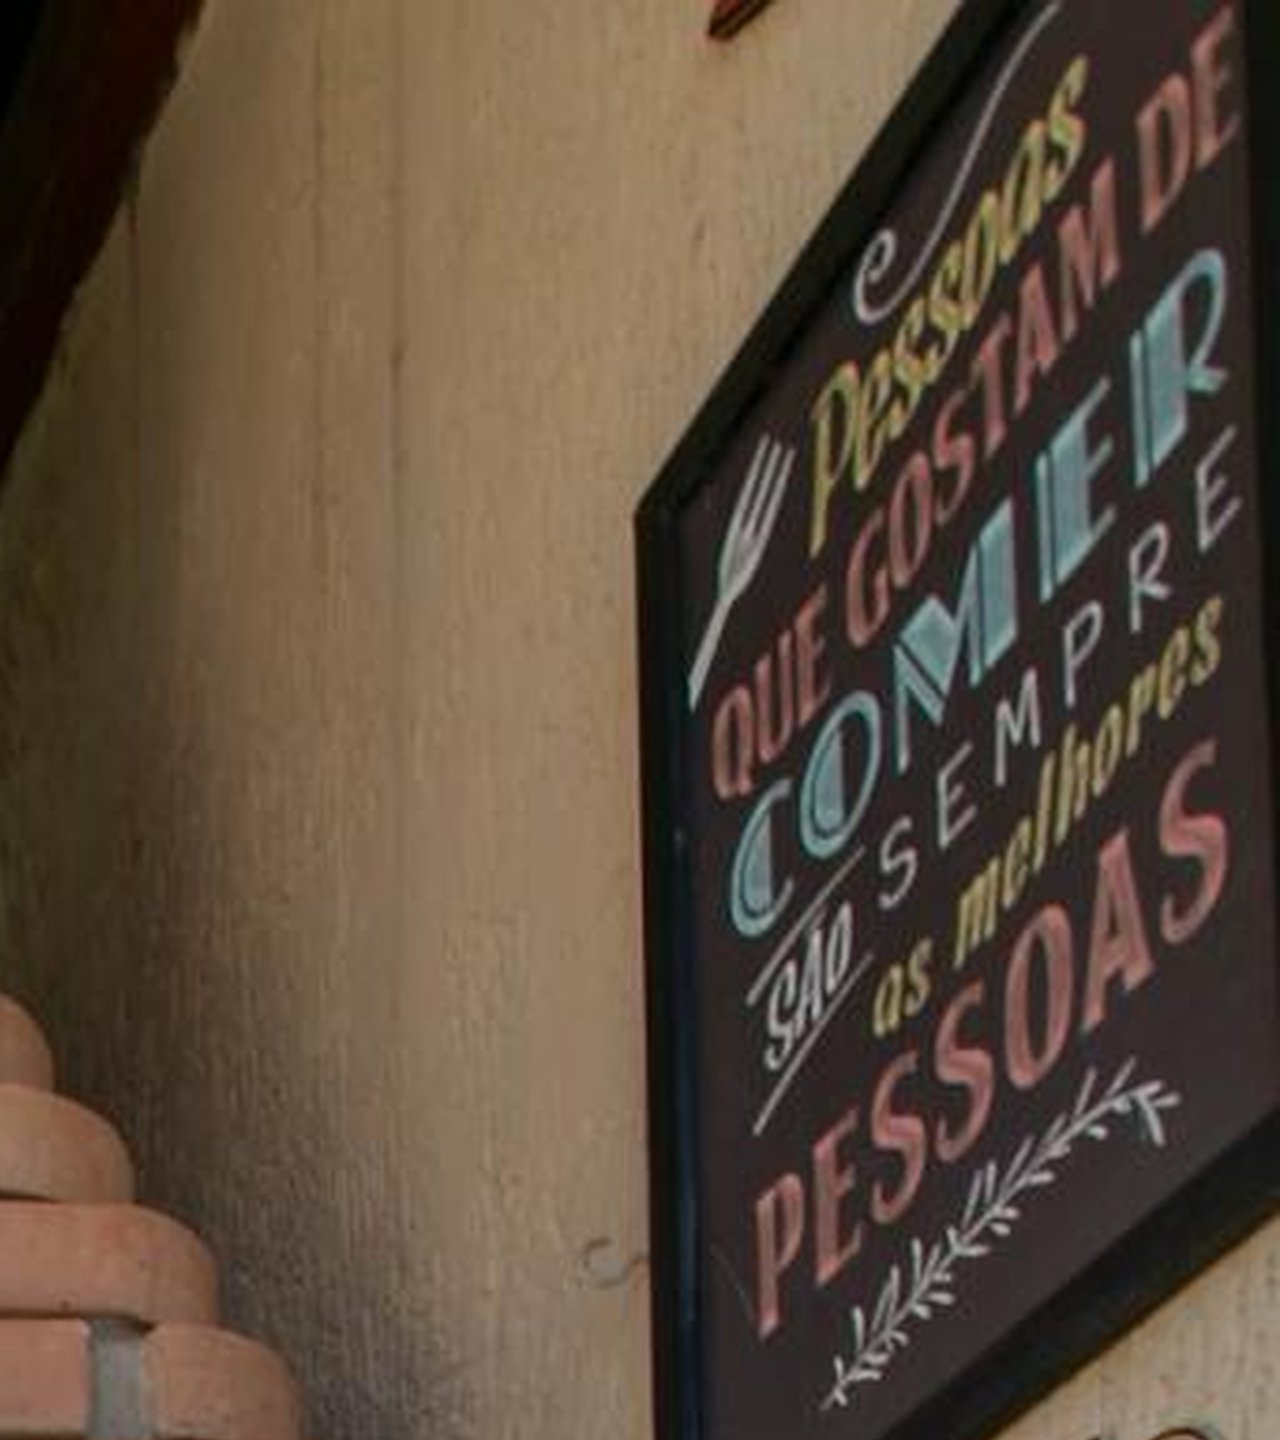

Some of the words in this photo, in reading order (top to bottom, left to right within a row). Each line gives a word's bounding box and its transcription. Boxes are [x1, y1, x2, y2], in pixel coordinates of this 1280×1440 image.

[709, 583, 831, 799] QUE
[846, 155, 1120, 649] GOSTAM
[1135, 5, 1239, 233] DE
[809, 54, 1088, 560] Pessoas
[730, 249, 1228, 938] COMER
[873, 937, 933, 1038] as
[952, 596, 1223, 970] melhores
[877, 426, 1239, 911] SEMPRE
[754, 739, 1229, 1339] PESSOAS
